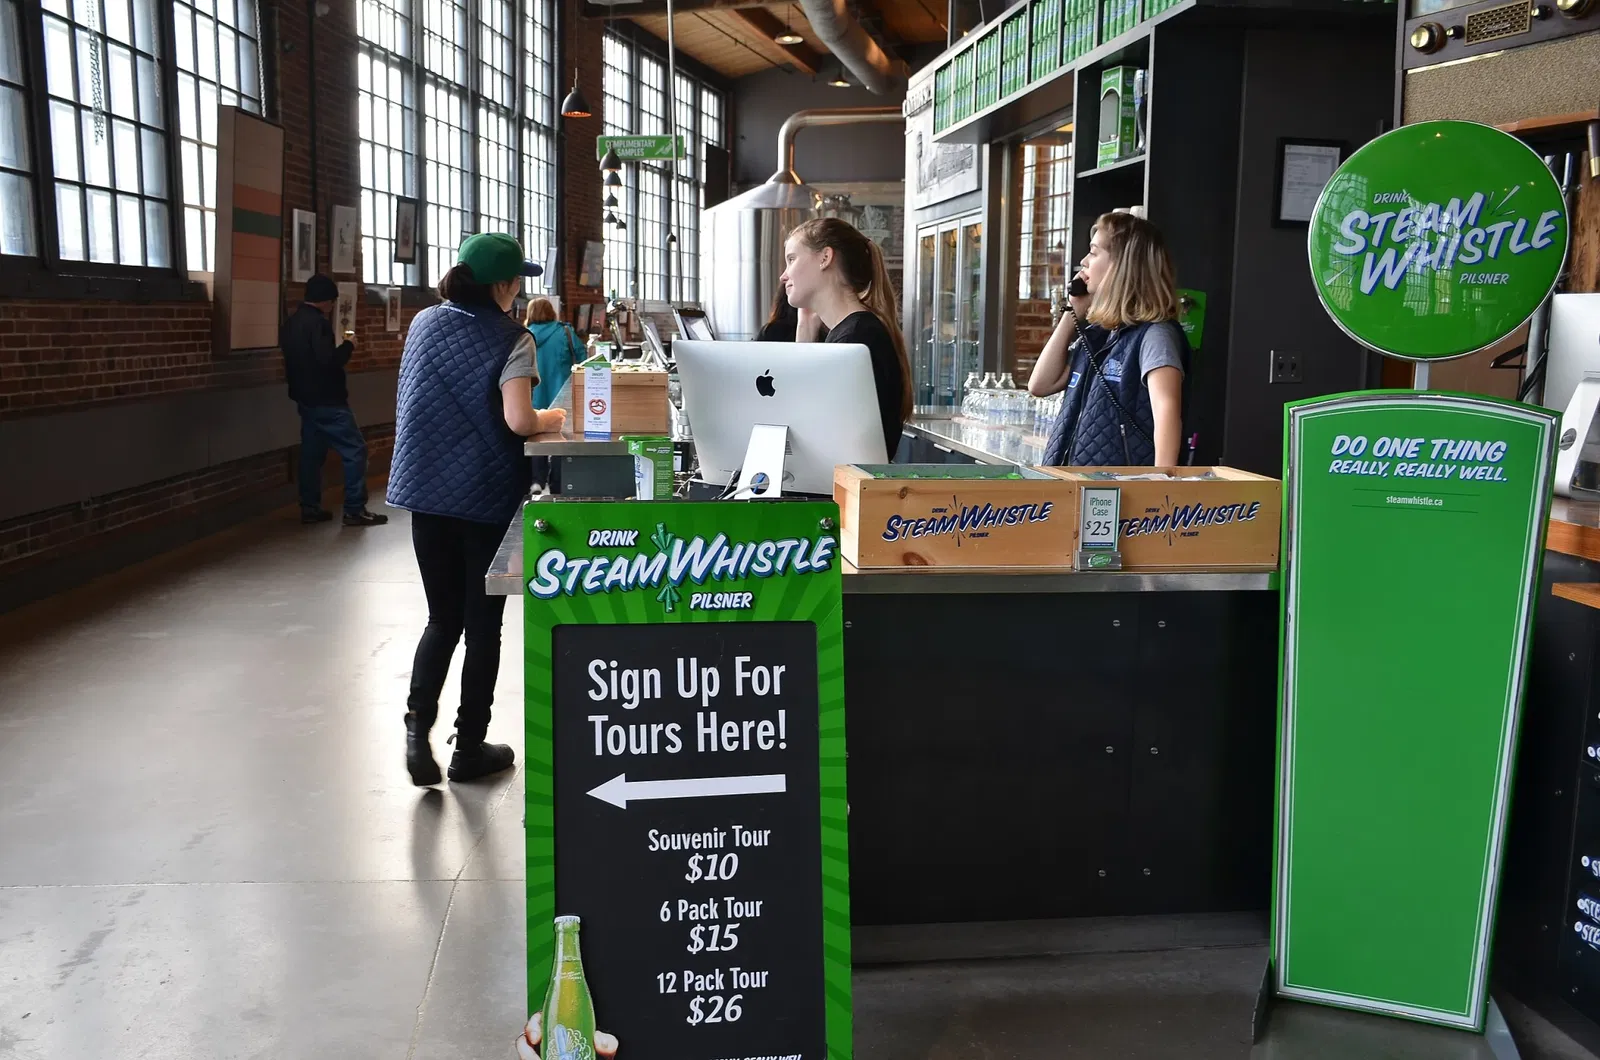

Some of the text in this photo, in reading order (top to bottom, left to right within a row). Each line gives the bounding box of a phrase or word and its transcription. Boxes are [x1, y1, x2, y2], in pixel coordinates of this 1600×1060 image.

[617, 148, 645, 157] SAMPLES
[1373, 192, 1411, 204] DRINK
[1333, 191, 1487, 256] STEAM
[1359, 209, 1562, 296] WHISTLE
[1459, 273, 1510, 285] PILSNER
[1330, 434, 1508, 464] DO ONE THING
[1328, 459, 1508, 483] REALLY, REALLY WELL.
[1089, 497, 1112, 507] iPhone
[1092, 507, 1109, 516] Case
[1386, 495, 1443, 507] steamwhistle.ca
[588, 529, 639, 548] DRINK
[1085, 520, 1113, 536] $25
[689, 592, 753, 611] PILSNER
[587, 655, 786, 710] Sign Up For
[587, 709, 788, 756] Tours Here!
[648, 824, 771, 851] Souvenir Tour
[684, 852, 739, 883] $10
[659, 896, 763, 922] 6 Pack Tour
[686, 923, 741, 955] $15
[656, 967, 769, 994] 12 Pack Tour
[686, 994, 744, 1026] $26
